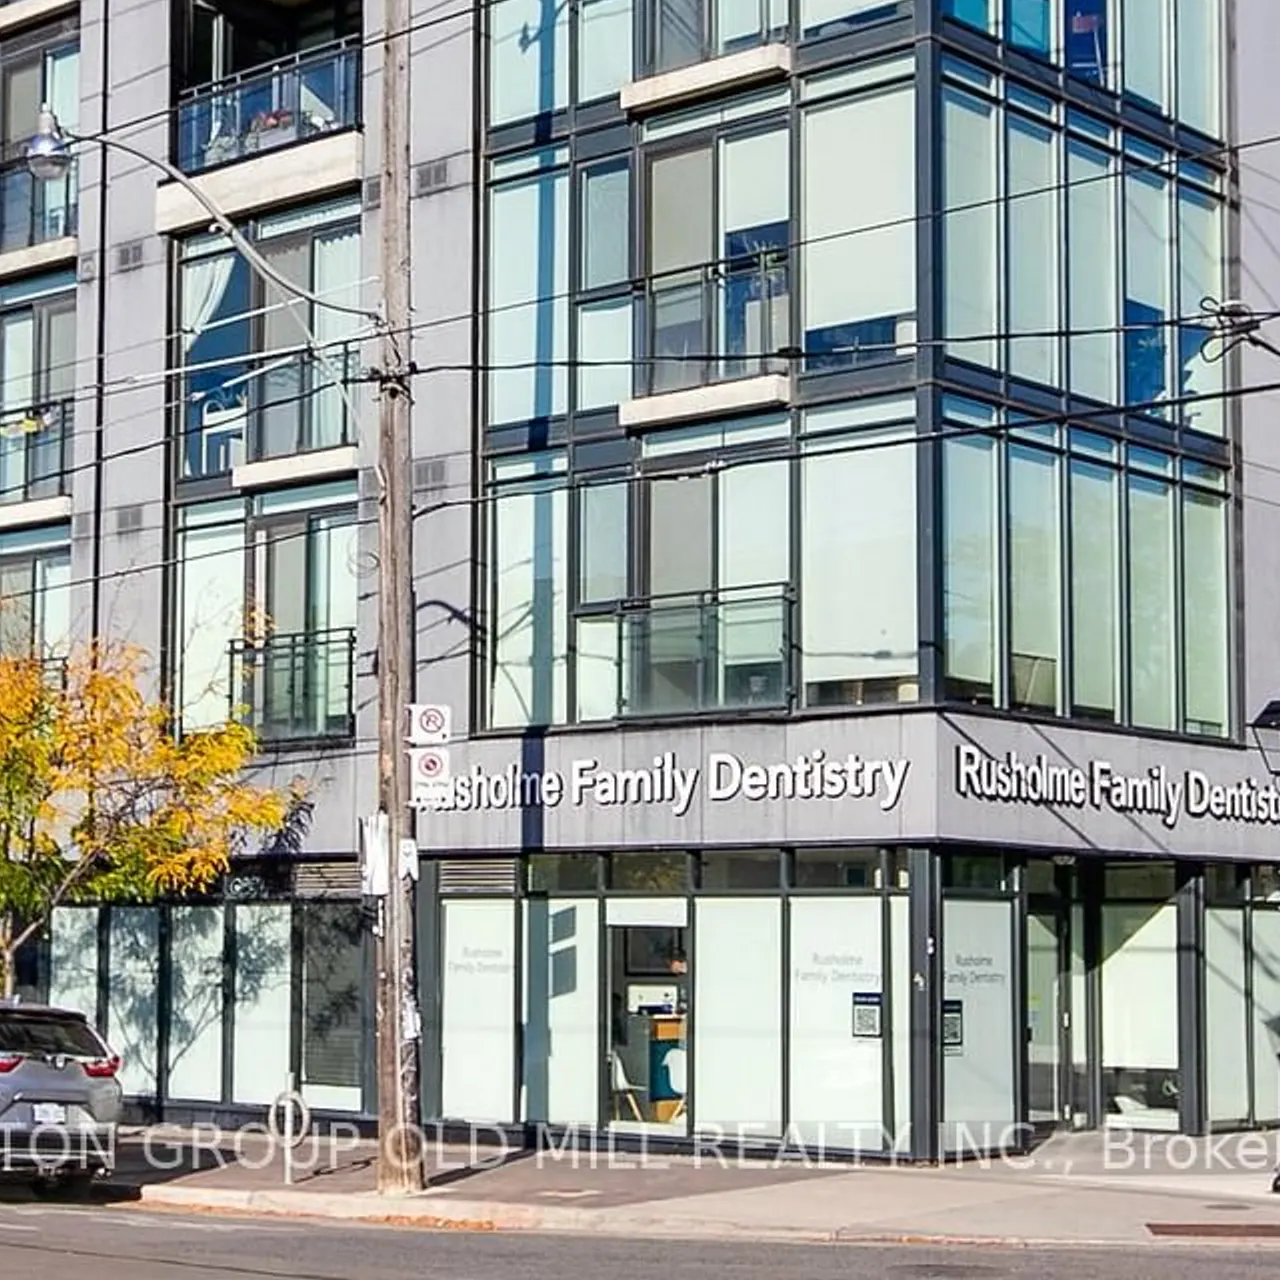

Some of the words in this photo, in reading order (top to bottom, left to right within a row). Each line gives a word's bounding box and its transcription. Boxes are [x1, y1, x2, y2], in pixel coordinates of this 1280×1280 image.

[572, 751, 699, 817] Family
[709, 749, 911, 812] Dentistry
[956, 744, 1087, 807] Rusholme
[1091, 761, 1183, 827] Family
